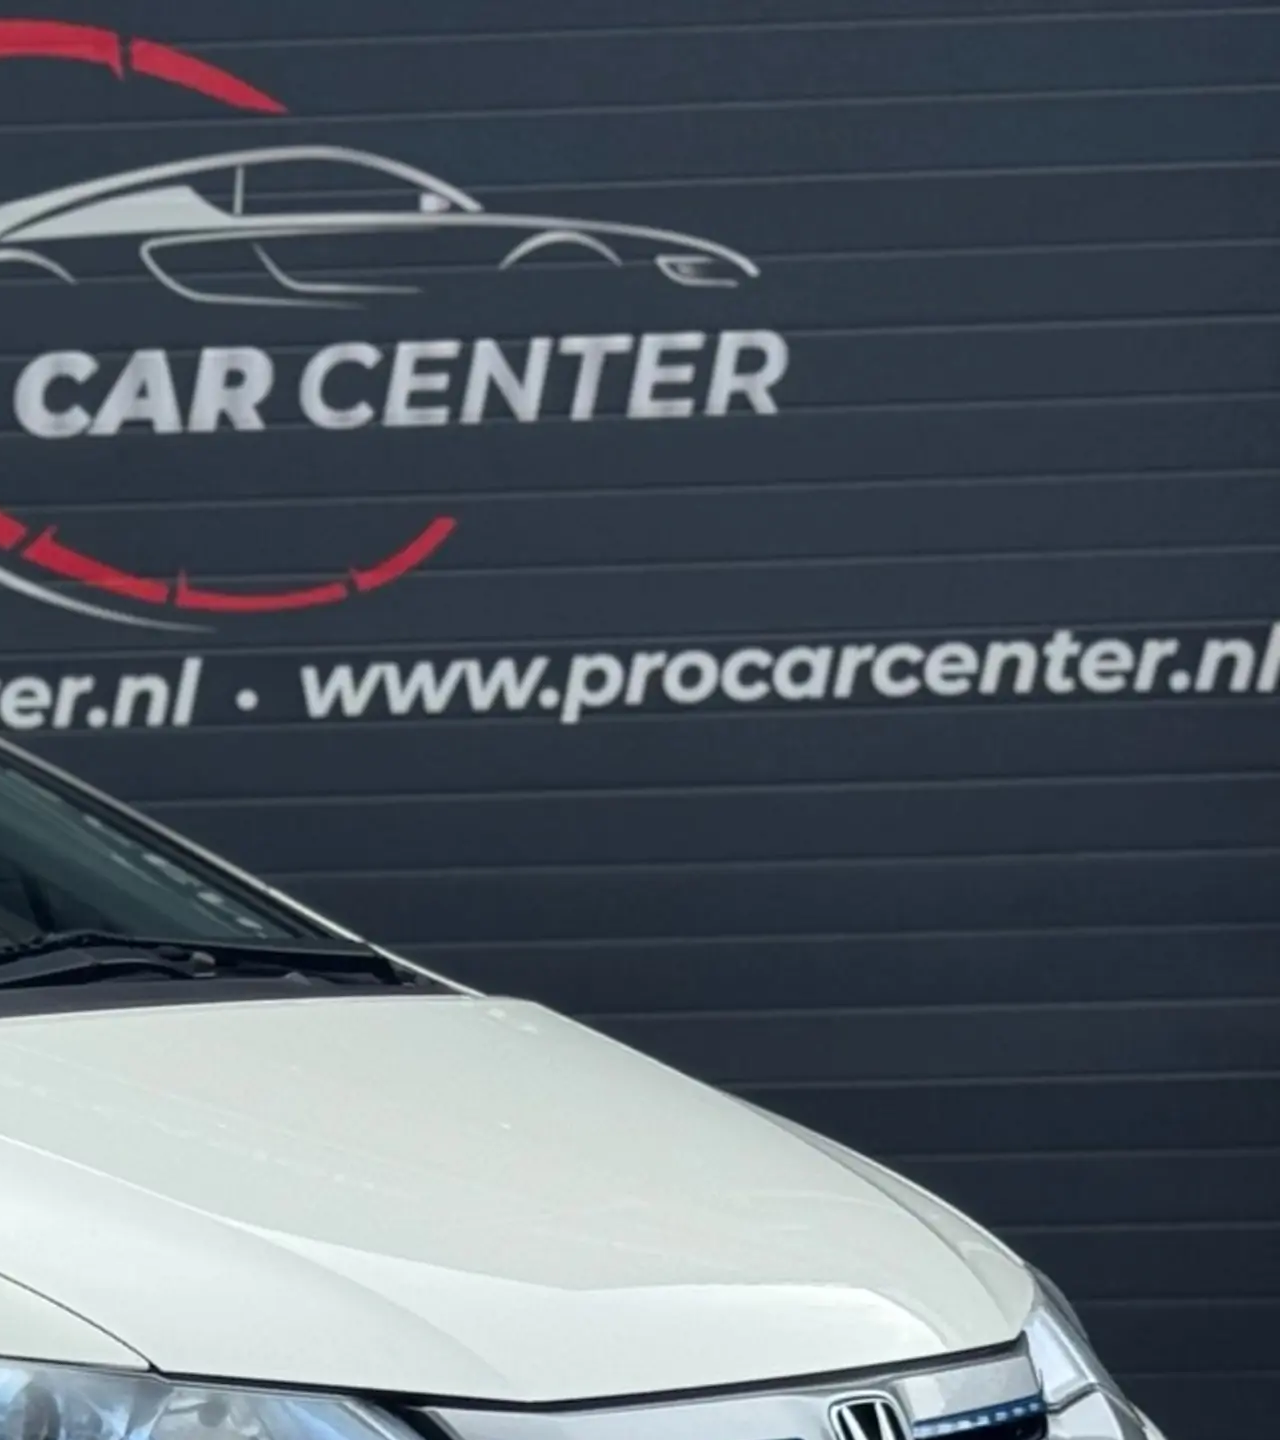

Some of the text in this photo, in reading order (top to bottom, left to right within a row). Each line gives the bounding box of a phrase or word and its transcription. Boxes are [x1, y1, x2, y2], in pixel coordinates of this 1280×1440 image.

[13, 346, 274, 438] CAR
[299, 328, 790, 430] CENTER
[300, 620, 1280, 725] www.procarcenter.nl
